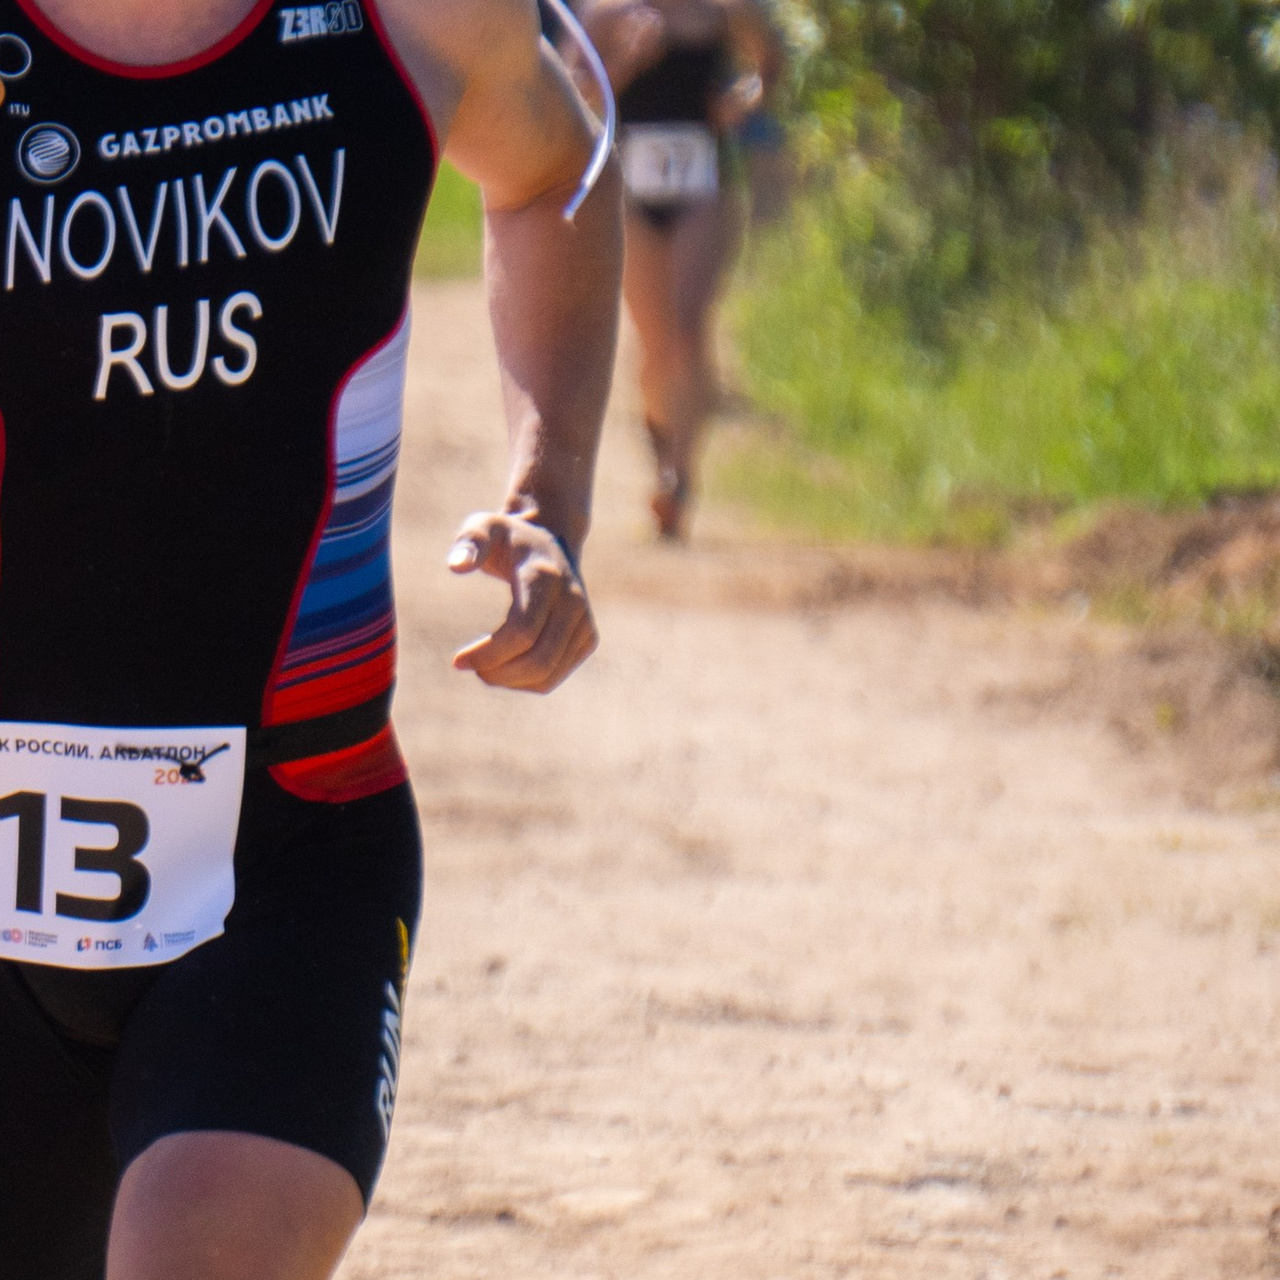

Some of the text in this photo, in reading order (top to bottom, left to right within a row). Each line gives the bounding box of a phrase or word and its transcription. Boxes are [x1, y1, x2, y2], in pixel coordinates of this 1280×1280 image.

[10, 103, 30, 116] ITU
[99, 94, 333, 158] GAZPROMBANK
[5, 149, 345, 291] NOVIKOV
[94, 292, 262, 399] RUS
[16, 739, 94, 759] РОССИИ.
[95, 939, 122, 950] ПСБ
